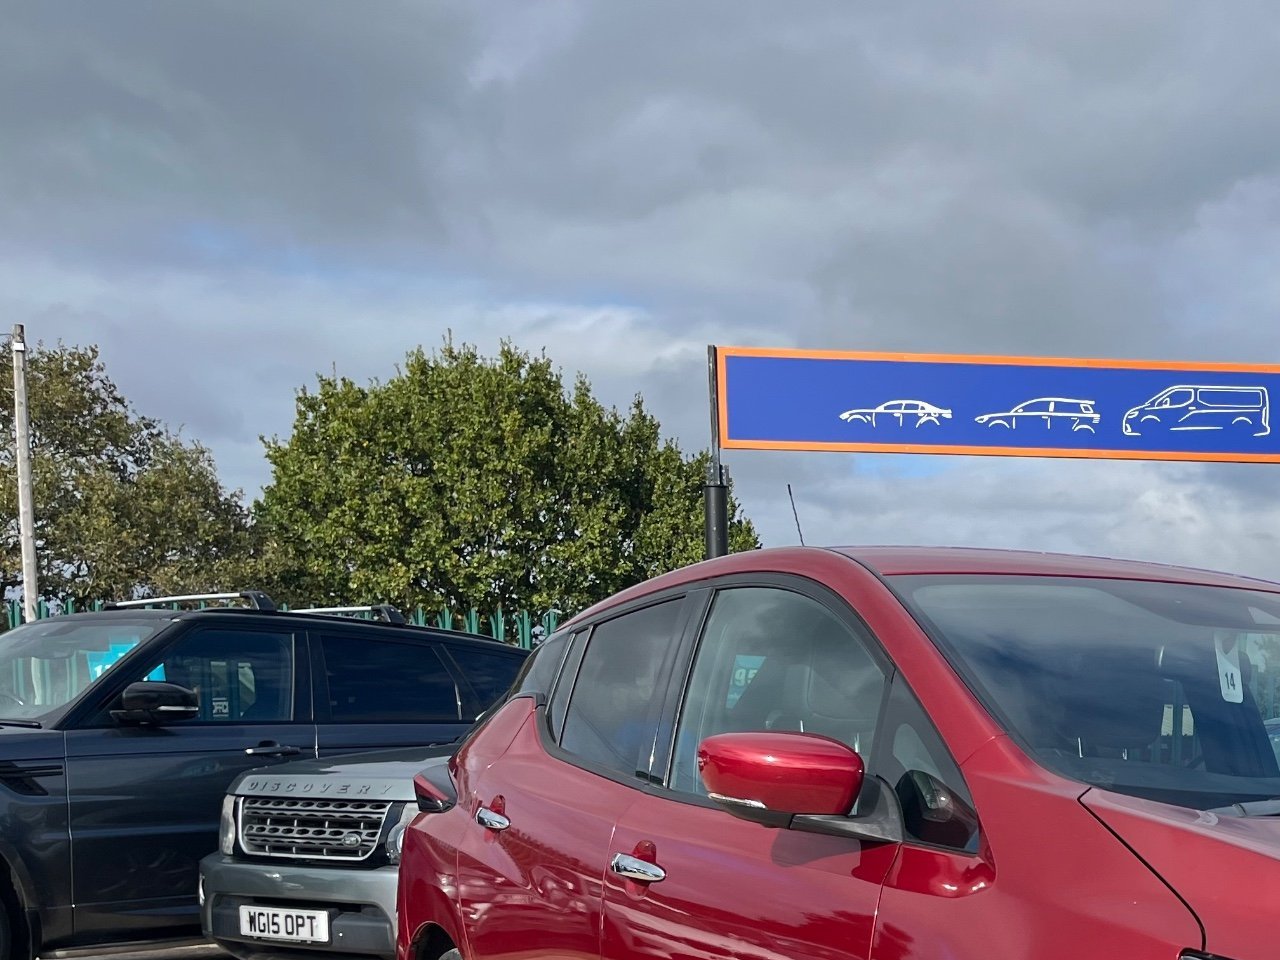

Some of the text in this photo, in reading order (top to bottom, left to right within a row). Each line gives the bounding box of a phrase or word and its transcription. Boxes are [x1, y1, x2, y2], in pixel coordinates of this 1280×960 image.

[248, 782, 393, 795] DISCOVERY
[248, 911, 317, 937] WG15 OPT
